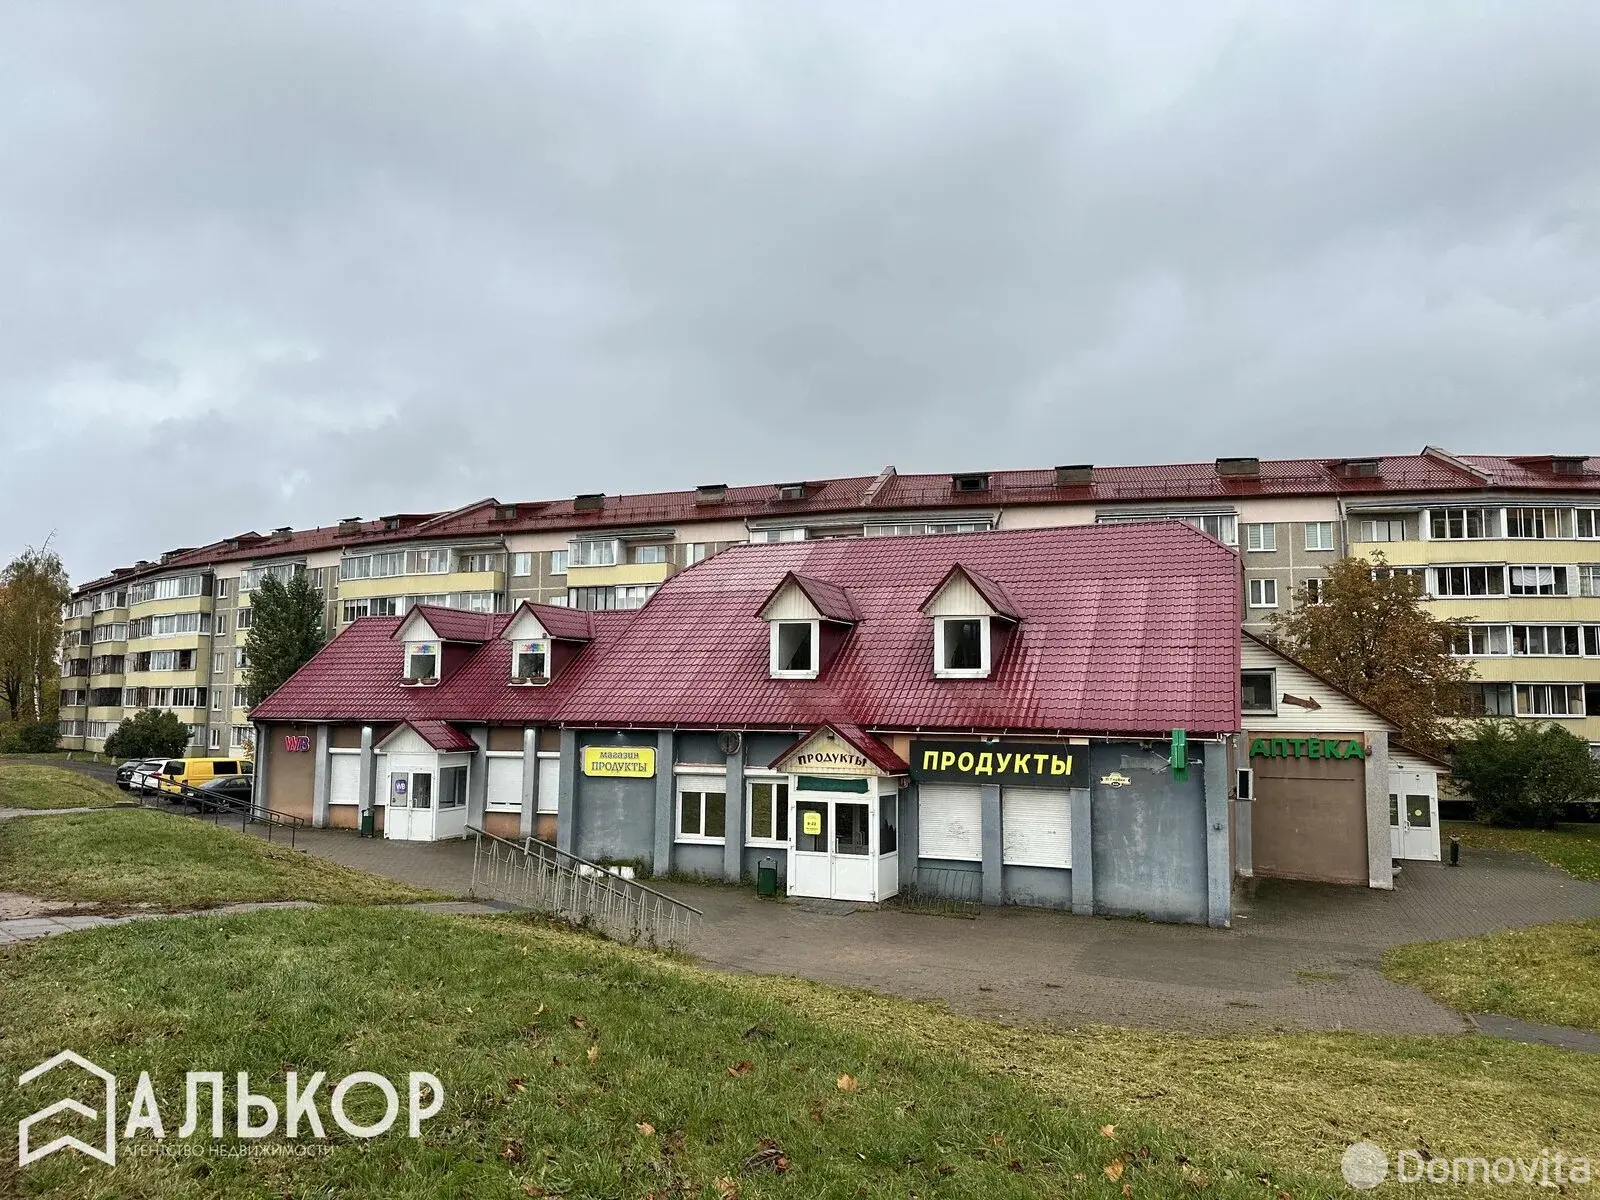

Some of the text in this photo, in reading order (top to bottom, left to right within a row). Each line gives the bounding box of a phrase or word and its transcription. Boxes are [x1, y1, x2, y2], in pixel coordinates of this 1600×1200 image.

[285, 735, 310, 752] WB
[1249, 737, 1365, 759] АПТЕКА
[600, 751, 639, 760] магазин
[797, 752, 867, 767] ПРОДУКТЫ
[922, 750, 1073, 776] ПРОДУКТЫ
[591, 761, 647, 773] ПРОДУКТЫ
